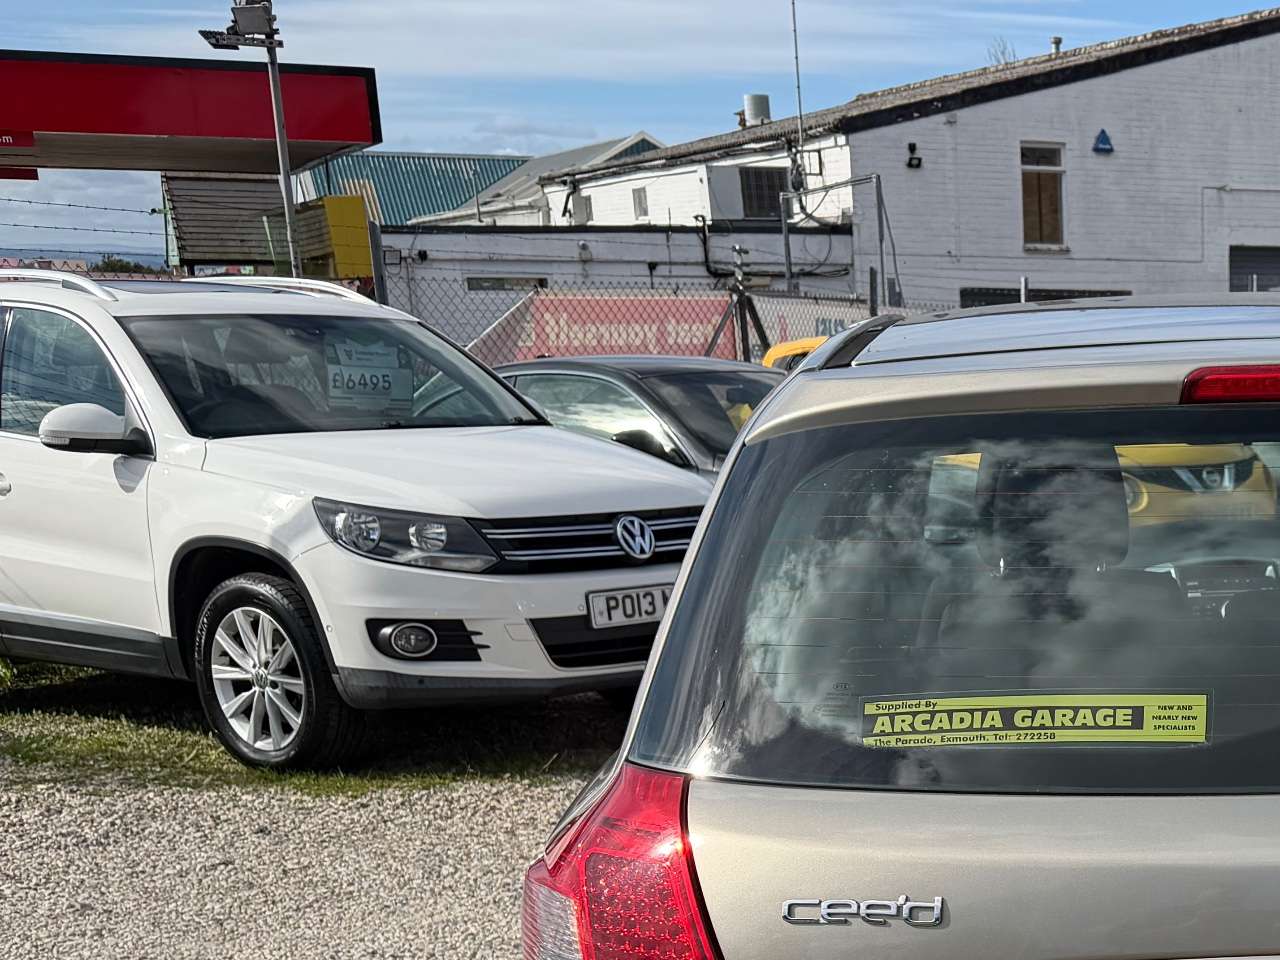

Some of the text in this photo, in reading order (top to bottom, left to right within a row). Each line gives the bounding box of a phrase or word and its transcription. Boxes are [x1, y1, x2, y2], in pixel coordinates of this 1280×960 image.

[332, 373, 391, 391] £6495
[605, 592, 657, 621] PO13
[875, 700, 938, 712] Supplied By
[872, 708, 1133, 734] ARCADIA GARAGE
[873, 738, 891, 747] The
